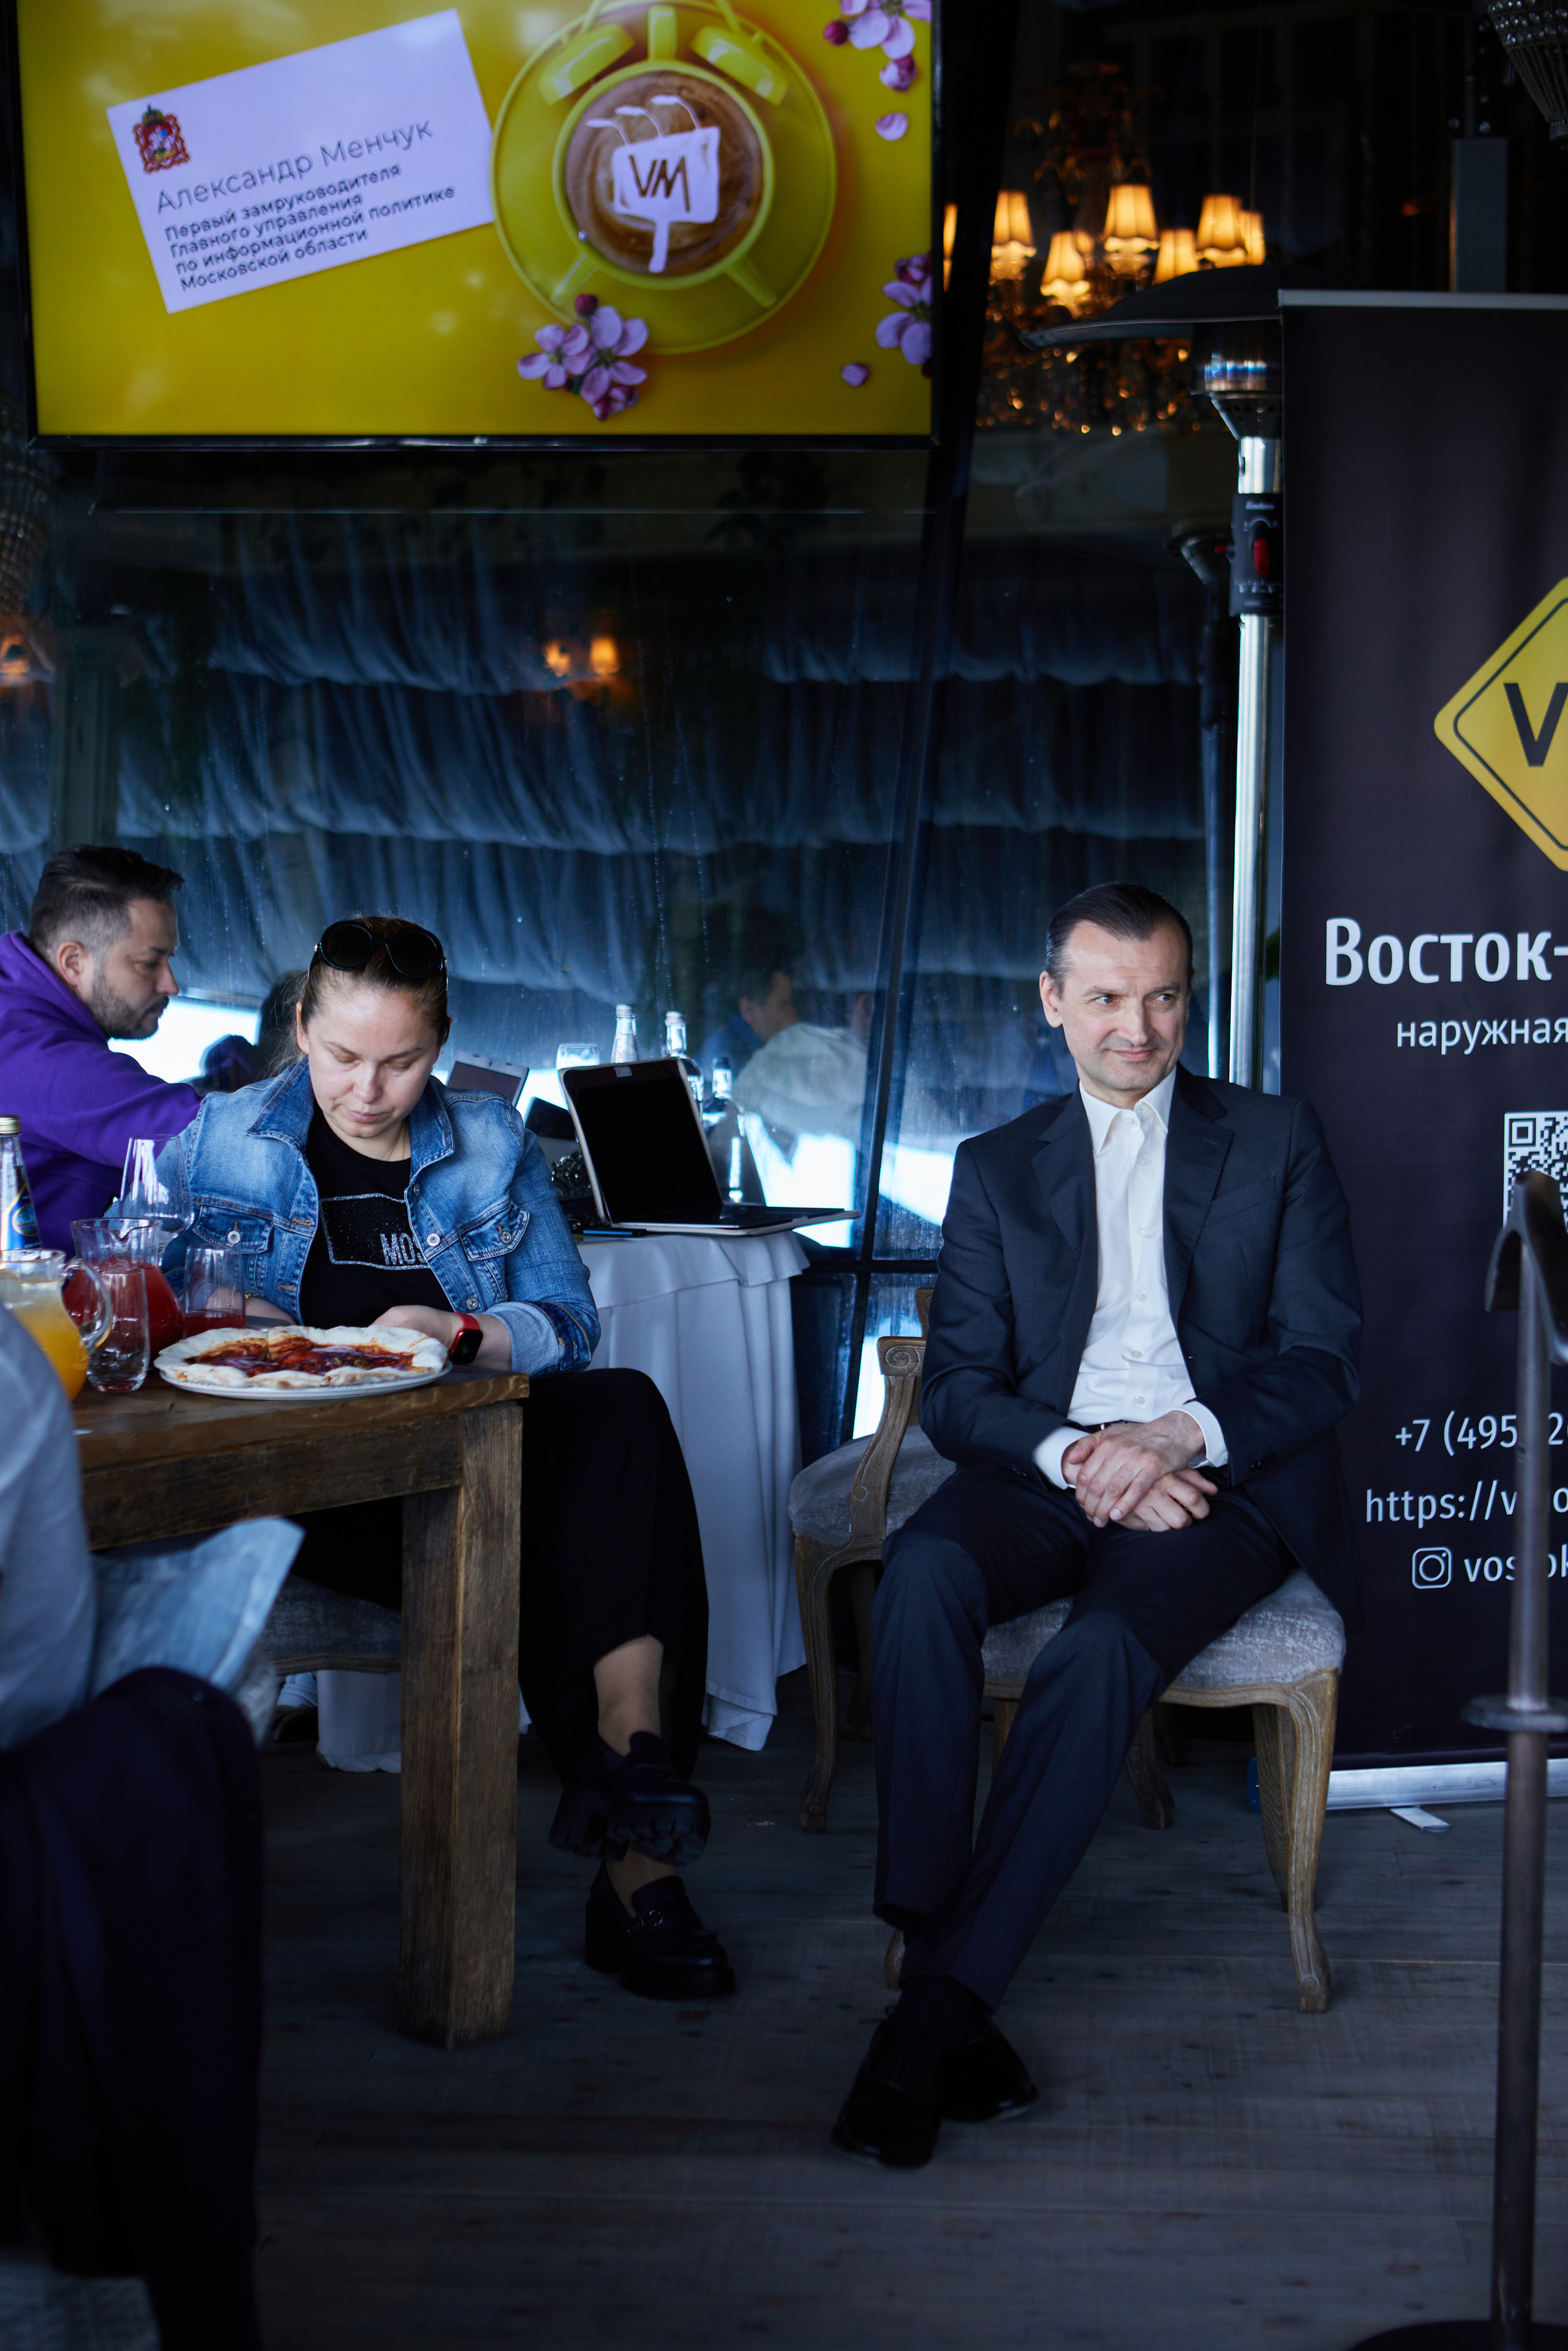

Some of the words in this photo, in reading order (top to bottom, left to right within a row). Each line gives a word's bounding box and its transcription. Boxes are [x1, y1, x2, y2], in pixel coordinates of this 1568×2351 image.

[157, 155, 313, 214] Александр
[320, 120, 432, 167] Менчук
[628, 154, 690, 213] VM
[165, 208, 237, 241] Первый
[241, 164, 401, 219] замруководителя
[170, 227, 250, 258] Главного
[254, 193, 363, 238] управления
[176, 260, 198, 275] по
[202, 209, 364, 267] информационной
[368, 186, 455, 220] политике
[180, 248, 290, 291] Московской
[295, 228, 367, 259] области
[1325, 917, 1568, 986] Восток-
[1396, 1017, 1568, 1055] наружная
[1395, 1419, 1430, 1452] +7
[1443, 1410, 1519, 1457] (495
[1366, 1479, 1568, 1529] https://vo
